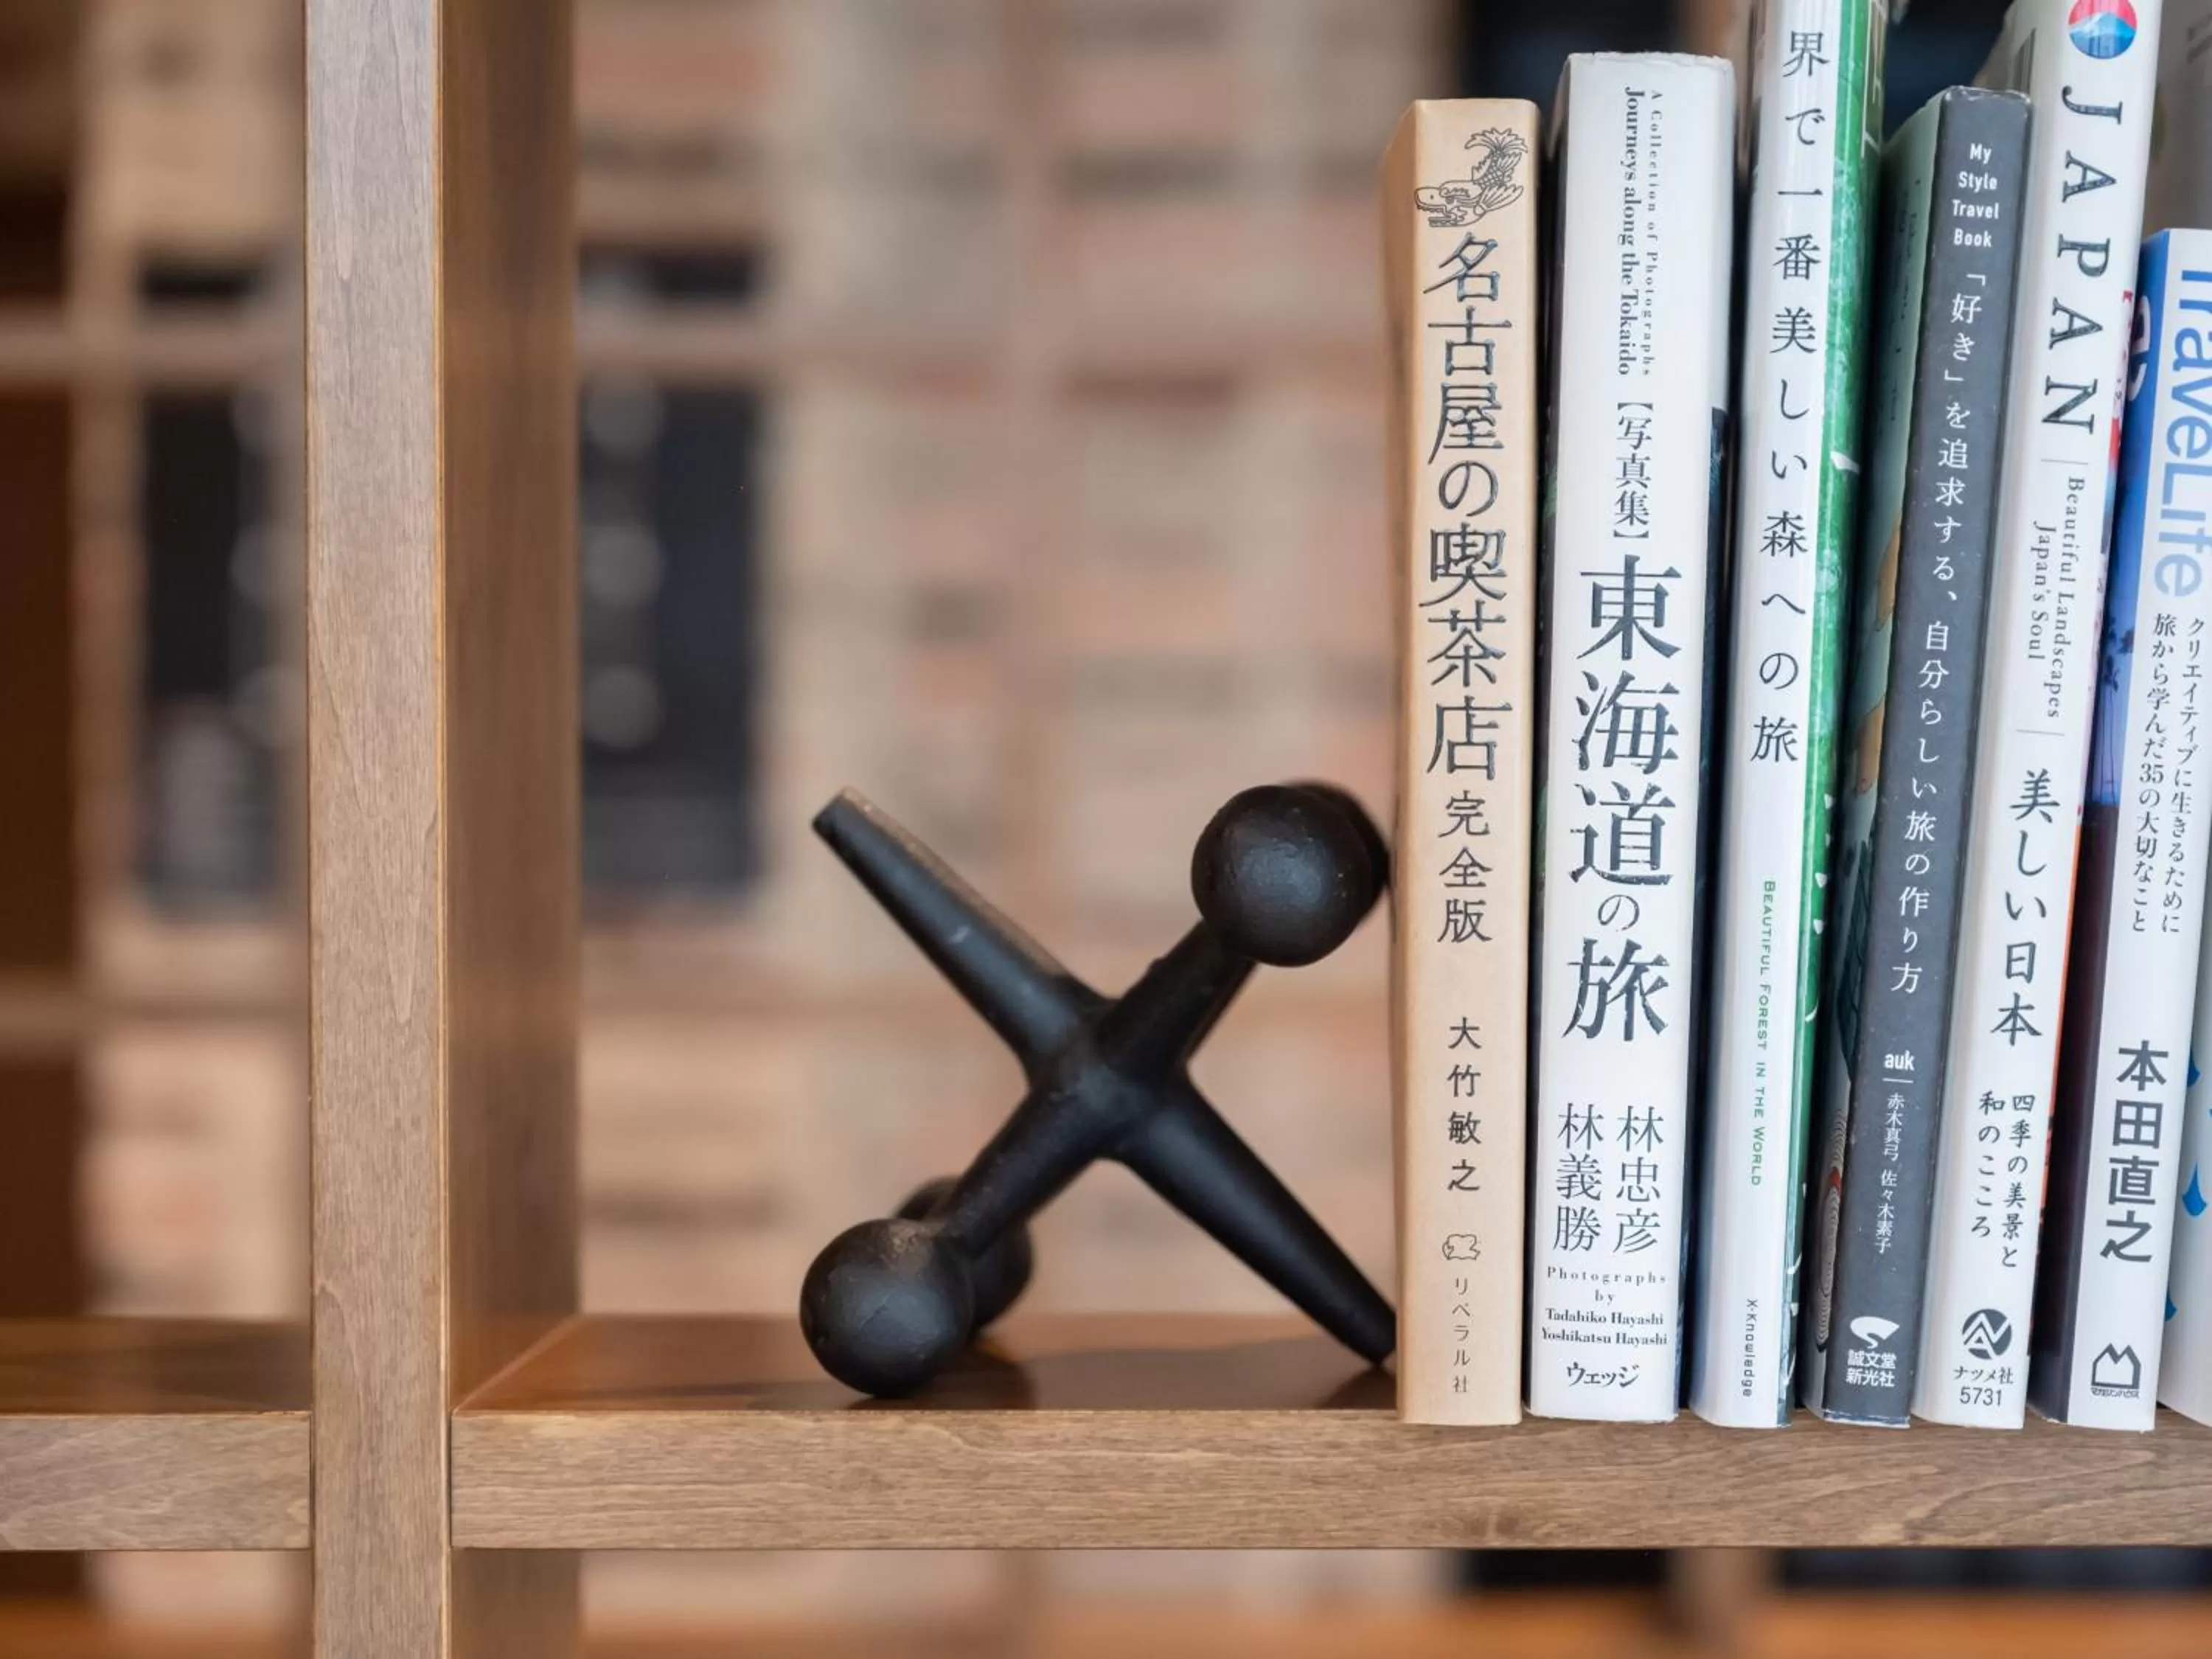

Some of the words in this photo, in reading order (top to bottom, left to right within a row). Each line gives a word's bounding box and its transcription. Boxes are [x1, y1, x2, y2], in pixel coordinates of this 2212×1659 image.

[1651, 89, 1663, 100] A
[1620, 86, 1646, 181] Journeys
[1647, 110, 1663, 212] Collection
[1969, 142, 1992, 165] My
[1618, 187, 1642, 246] along
[1952, 198, 2000, 220] Travel
[1958, 170, 1997, 193] Style
[1646, 221, 1658, 241] of
[1953, 228, 1992, 248] Book
[2041, 86, 2124, 435] JAPAN
[1621, 253, 1641, 285] the
[1618, 288, 1639, 375] Tokaido
[1640, 251, 1658, 375] Photographs
[1750, 29, 1830, 763] 界で一番美しい森への旅
[1419, 232, 1513, 781] 名古屋の喫茶店
[1613, 402, 1654, 539] 【写真集】
[2030, 521, 2057, 602] Japan's
[2059, 476, 2086, 582] Beautiful
[1890, 272, 1987, 995] 「好き」を追求する、自分らしい旅の作り方
[2028, 611, 2049, 660] Soul
[2044, 591, 2075, 717] Landscapes
[1562, 554, 1682, 1042] 東海道の旅
[2132, 613, 2177, 933] 旅から学んだ35の大切なこと
[2162, 617, 2205, 933] クリエイティブに生きるために
[1437, 790, 1493, 944] 完全版
[1760, 880, 1776, 976] BEAUTIFUL
[1990, 768, 2061, 1047] 美しい日本
[1757, 984, 1772, 1051] FOREST
[1756, 1062, 1766, 1077] IN
[1884, 1051, 1915, 1071] auk
[1447, 1017, 1482, 1192] 大竹敏之
[1754, 1086, 1765, 1119] THE
[1883, 1092, 1905, 1162] 赤木真弓
[1554, 1102, 1604, 1251] 林義勝
[1613, 1105, 1664, 1253] 林忠彦
[1750, 1126, 1765, 1186] WORLD
[1971, 1090, 2005, 1238] 和のこころ
[2000, 1093, 2036, 1268] 四季の美景と
[2099, 1040, 2169, 1263] 本田直之
[1548, 1265, 1666, 1287] Photographs
[1595, 1289, 1615, 1304] by
[1542, 1326, 1611, 1344] Yoshikatsu
[1615, 1331, 1668, 1348] Hayashi
[1545, 1308, 1607, 1324] Tadahiko
[1611, 1311, 1664, 1328] Hayashi
[1566, 1361, 1640, 1388] ウェッジ
[1846, 1349, 1897, 1370] 誠文堂
[1846, 1367, 1896, 1388] 新光社
[1954, 1366, 2013, 1384] ナツメ社
[1959, 1385, 2002, 1407] 5731
